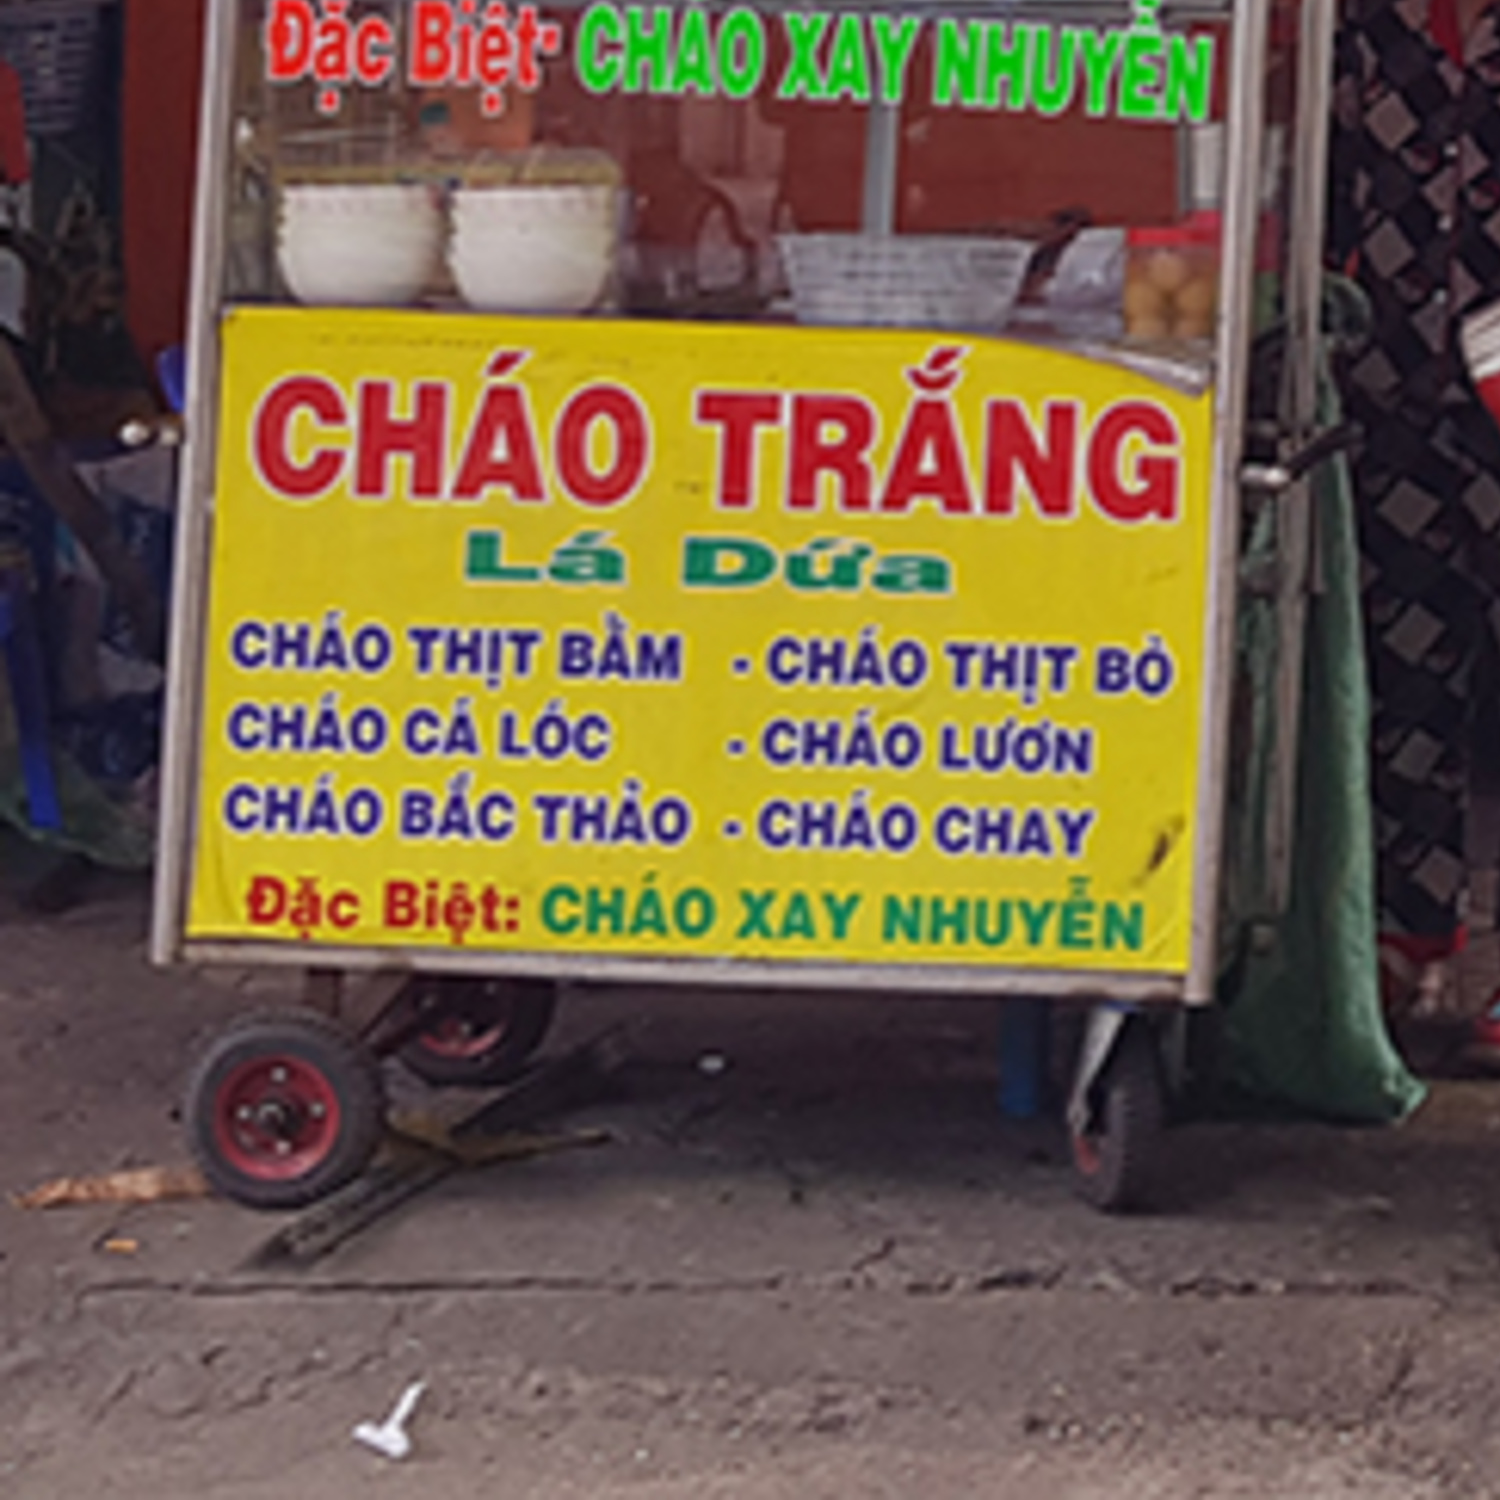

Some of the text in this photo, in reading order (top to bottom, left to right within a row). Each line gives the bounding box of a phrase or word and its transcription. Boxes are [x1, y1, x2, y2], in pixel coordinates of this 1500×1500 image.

[777, 11, 921, 102] XAY
[250, 345, 1184, 525] CHÁO TRẮNG
[465, 528, 953, 595] Lá Dứa
[229, 610, 393, 675] CHÁO
[405, 626, 543, 690] THỊT
[764, 624, 930, 690] CHÁO
[944, 642, 1078, 706] THỊT
[226, 692, 612, 763] CHÁO CÁ LÓC
[760, 707, 1094, 775] CHÁO LƯƠN
[222, 770, 694, 847] CHÁO BẮC THẢO
[757, 789, 1097, 859] CHÁO CHAY
[247, 875, 361, 942] Đặc
[540, 870, 718, 940] CHÁO
[735, 887, 864, 941] XAY
[881, 874, 1147, 953] NHUYỄN
